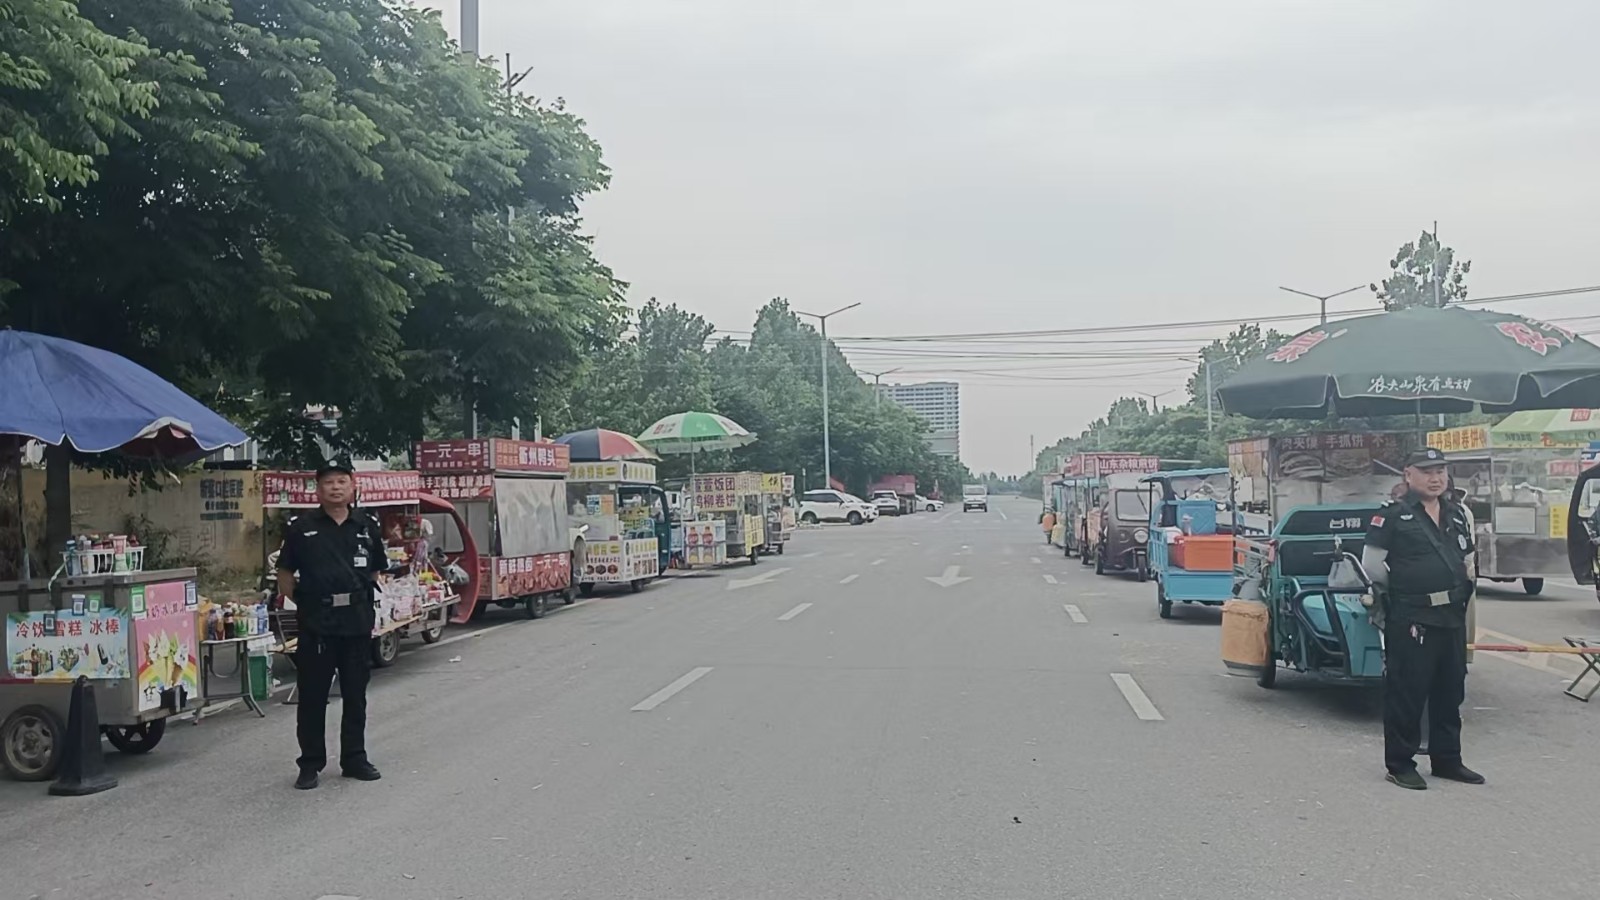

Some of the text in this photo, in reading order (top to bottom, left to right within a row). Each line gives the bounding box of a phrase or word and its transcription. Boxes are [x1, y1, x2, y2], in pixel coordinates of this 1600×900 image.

[1367, 374, 1472, 395] 农夫山泉有点甜
[1325, 433, 1364, 449] 手抓饼
[423, 443, 481, 458] 一元一串
[1099, 458, 1158, 469] 山东杂粮煎饼
[536, 553, 568, 569] 一元一串
[16, 618, 120, 639] 冷饮 雪糕 冰棒
